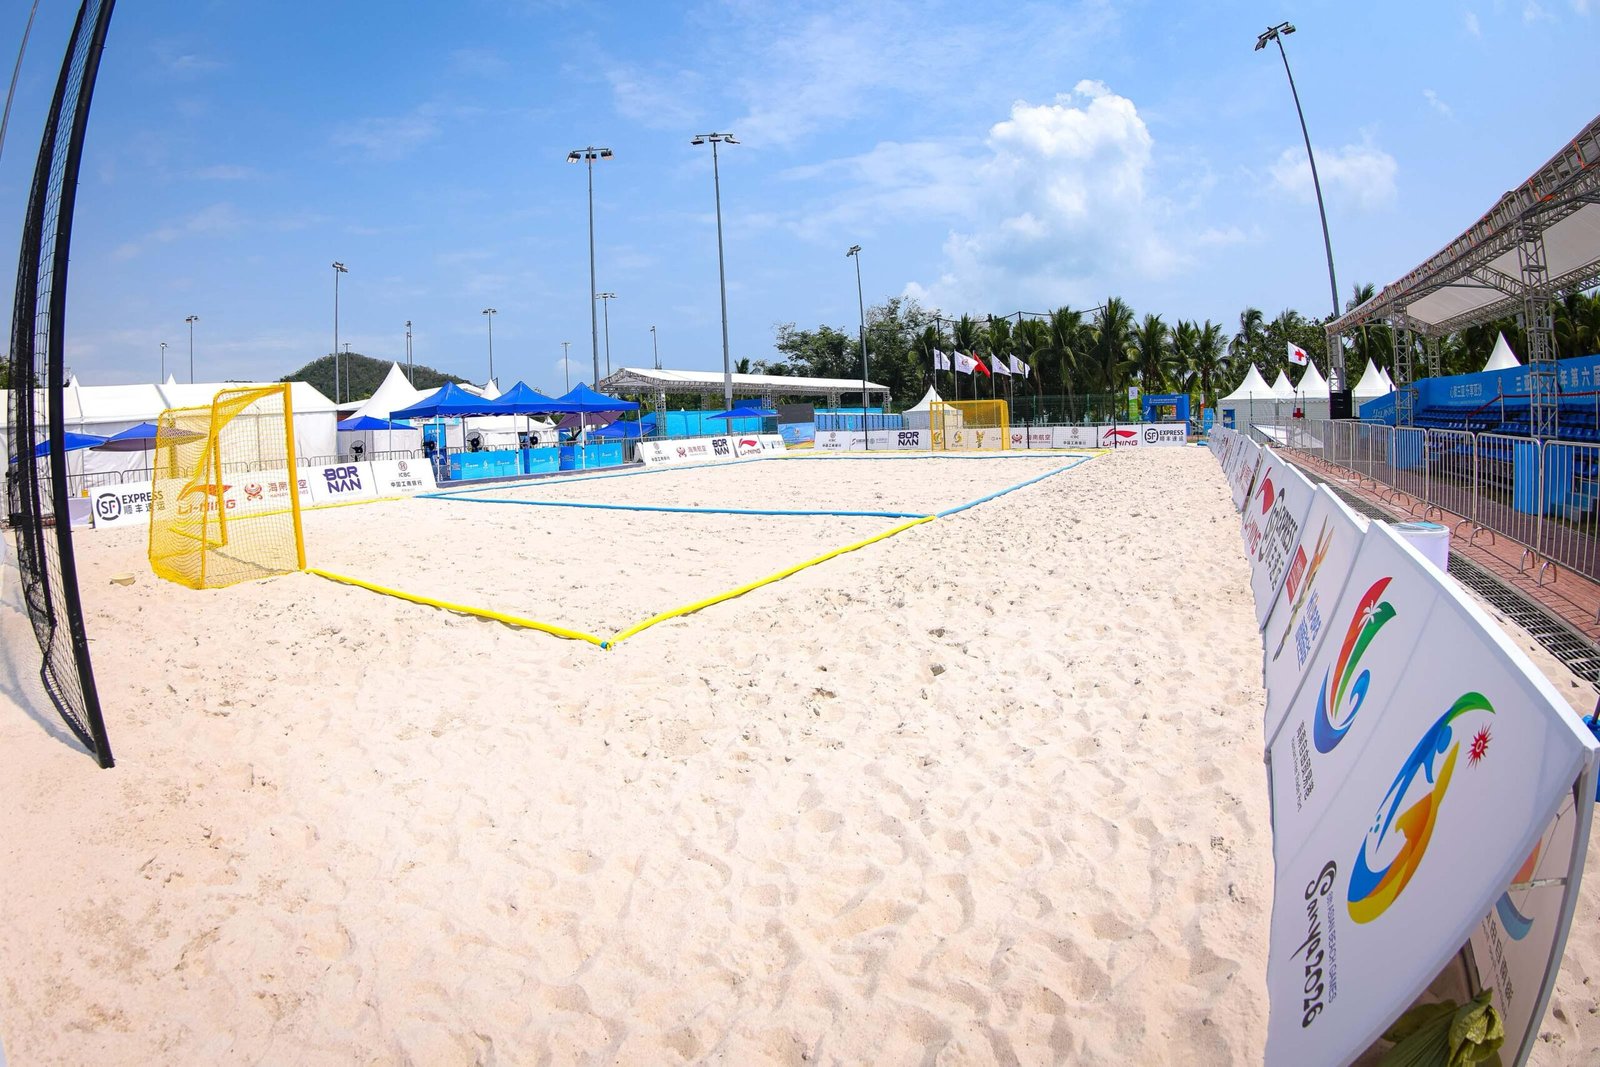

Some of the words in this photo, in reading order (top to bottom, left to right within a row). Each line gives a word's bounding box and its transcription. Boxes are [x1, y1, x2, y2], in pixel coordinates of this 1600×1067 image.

[898, 431, 919, 439] BOR
[712, 438, 729, 448] BOR
[714, 446, 730, 456] NAN
[740, 447, 761, 456] LI-NING
[322, 465, 359, 481] BOR
[268, 479, 307, 492] 海南空
[327, 478, 362, 494] NAN
[390, 479, 422, 488] 中国工商银行
[101, 501, 115, 514] SF
[122, 490, 164, 505] EXPRESS
[123, 501, 165, 515] 顺丰速运
[1328, 929, 1336, 965] BEACH
[1328, 963, 1337, 1003] GAMES
